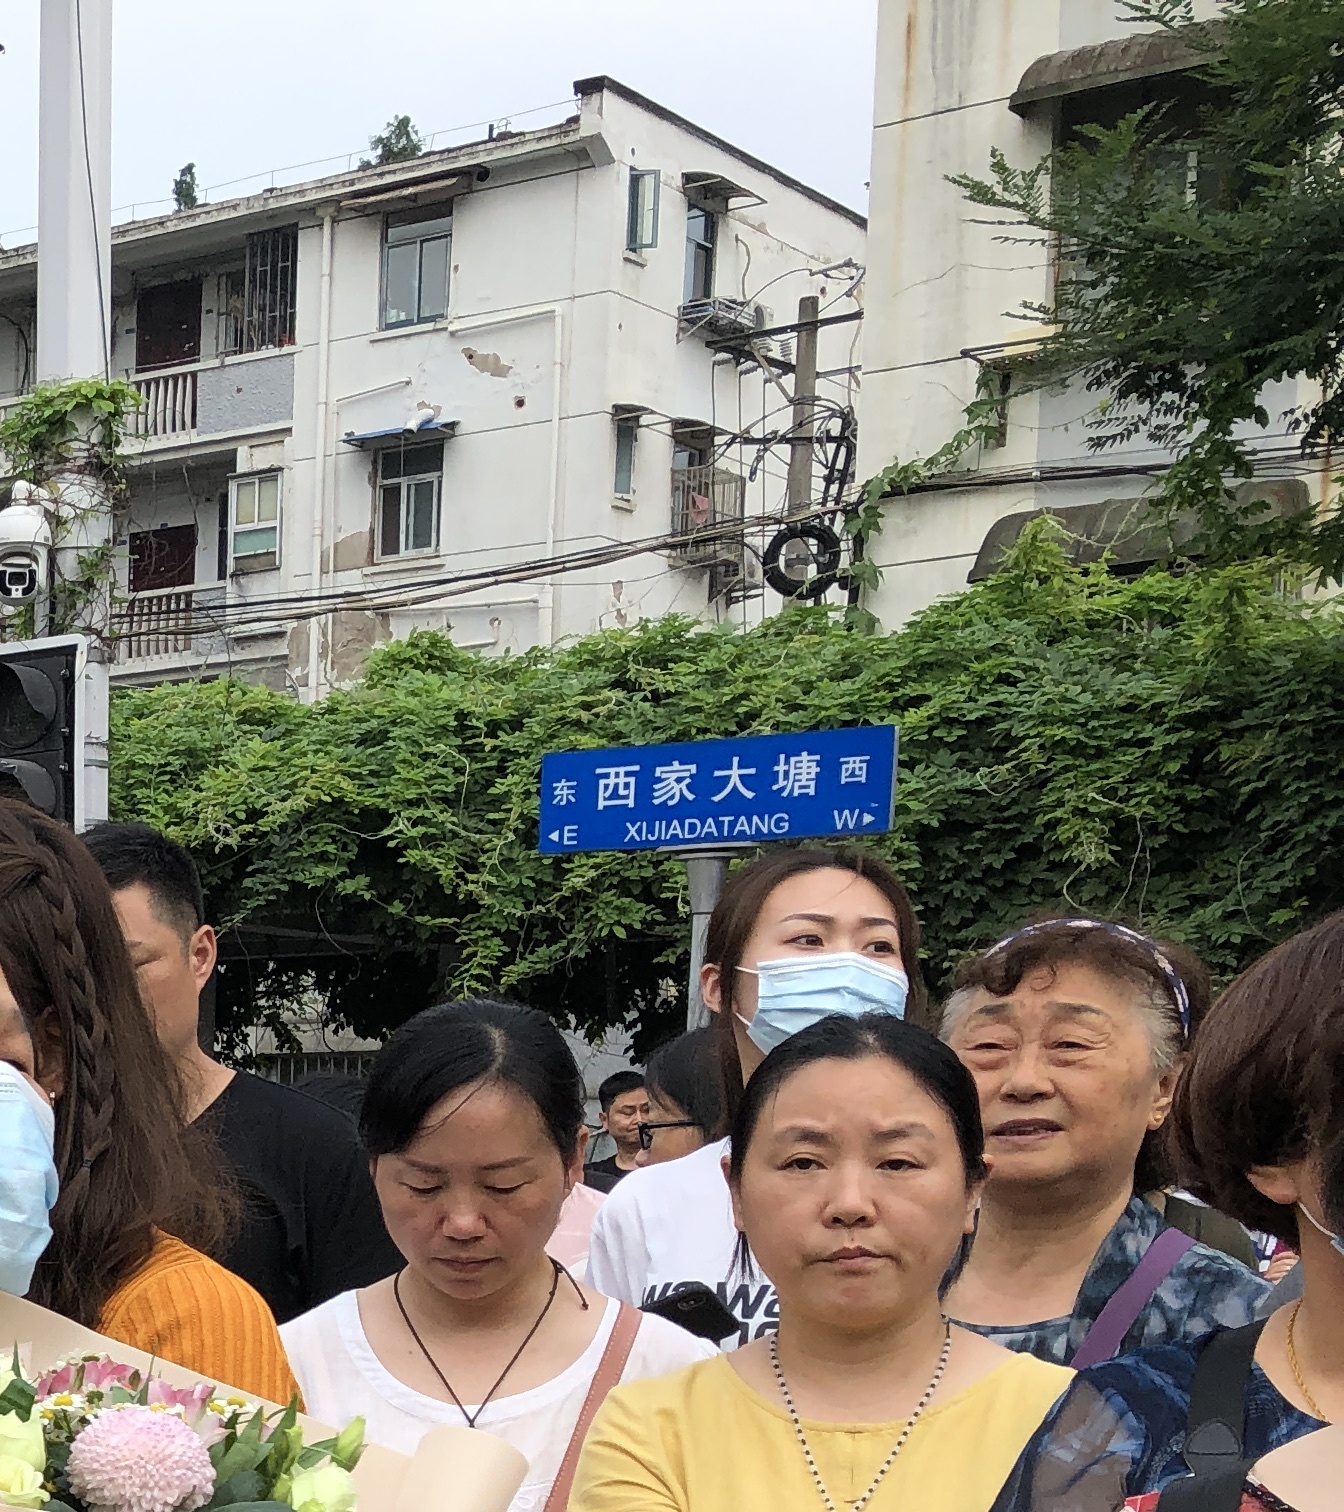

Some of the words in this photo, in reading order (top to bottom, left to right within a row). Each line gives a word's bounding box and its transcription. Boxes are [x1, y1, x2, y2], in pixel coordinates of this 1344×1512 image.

[552, 778, 577, 807] 东
[594, 751, 822, 811] 西家大塘
[839, 754, 871, 786] 西
[563, 825, 579, 846] E
[624, 812, 791, 843] XIJIADATANG
[833, 808, 860, 831] W
